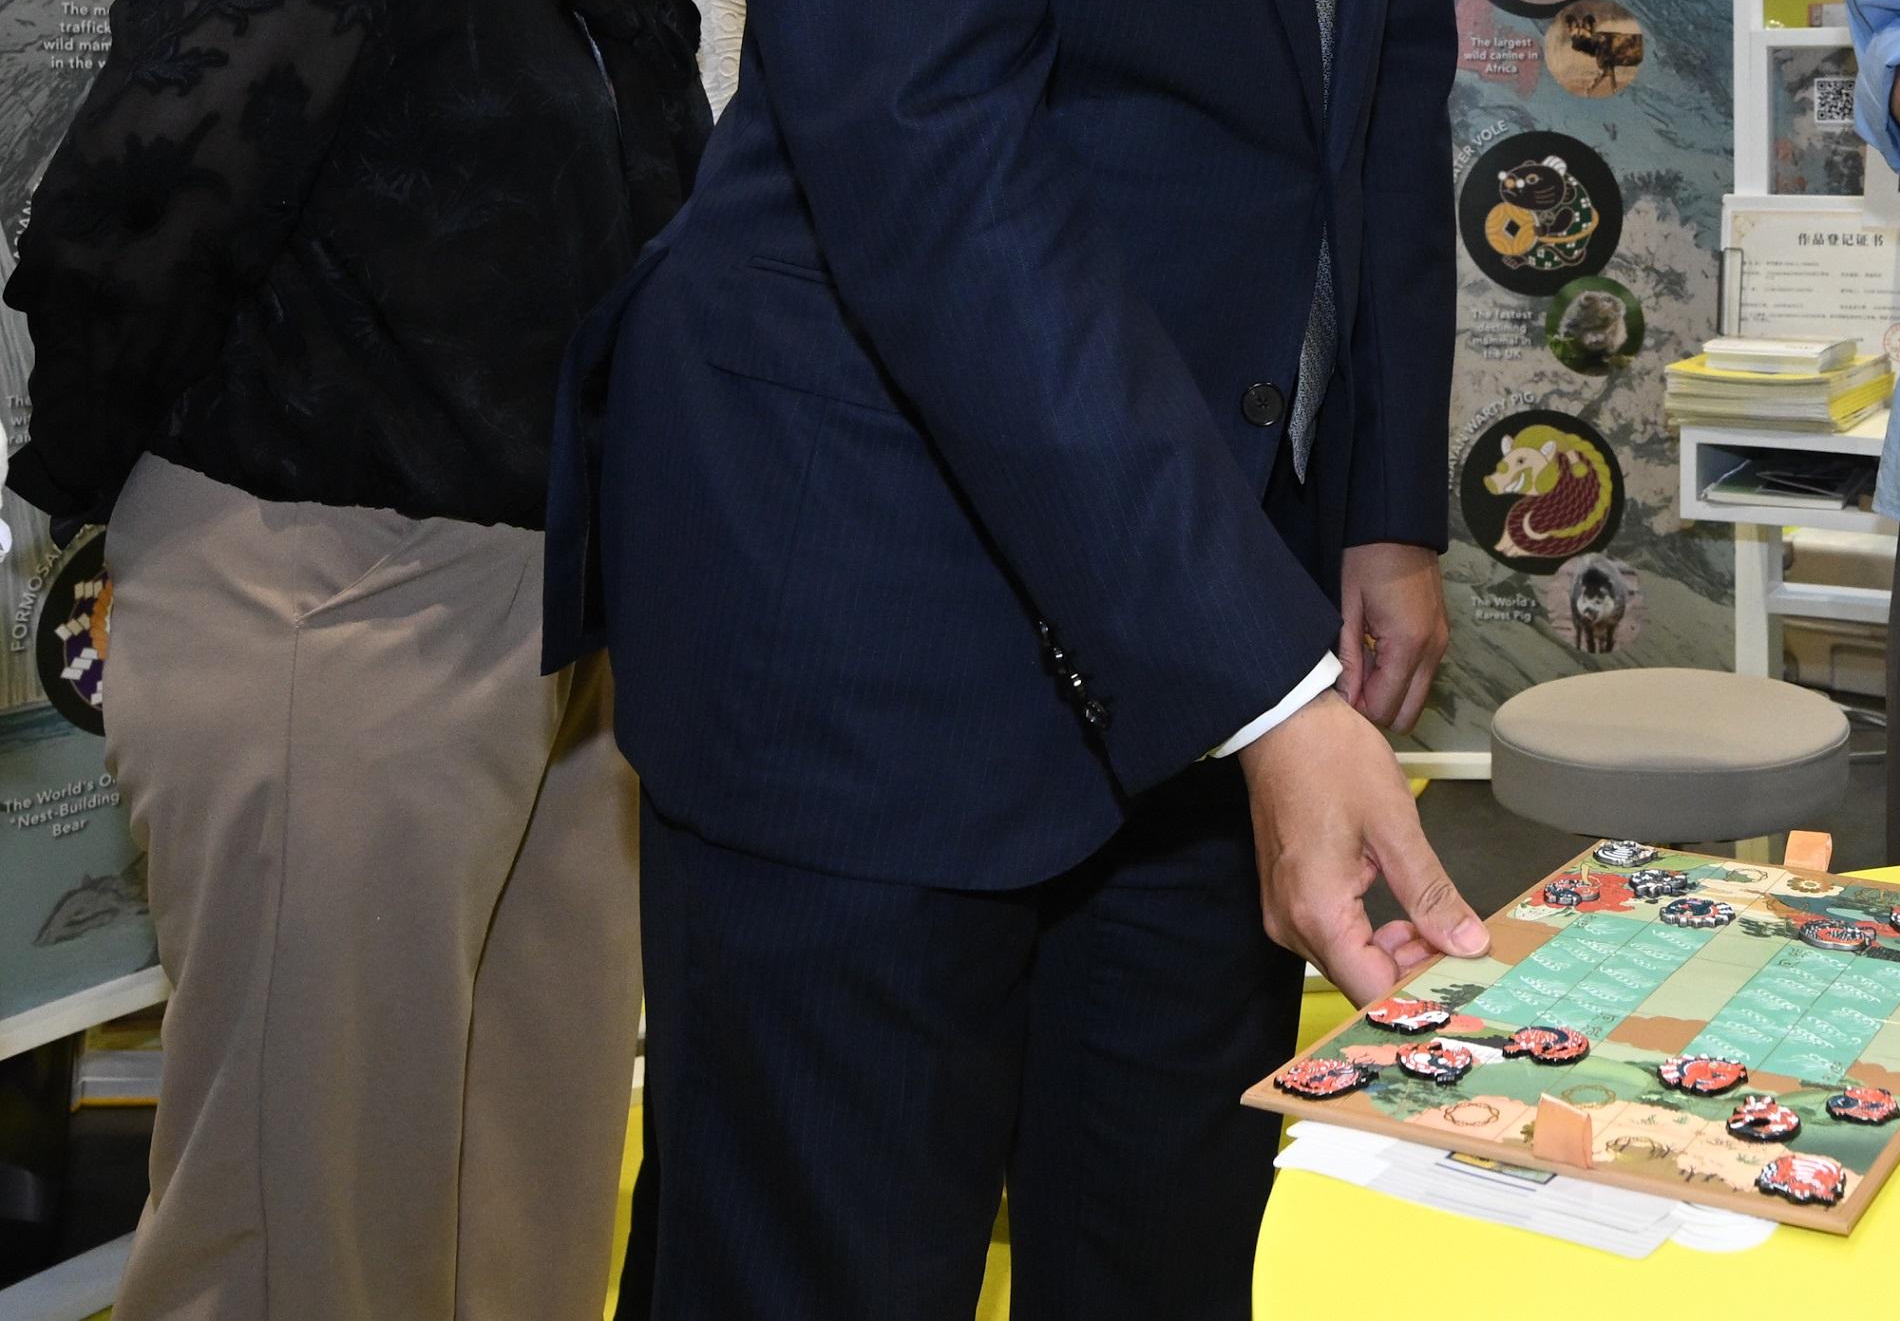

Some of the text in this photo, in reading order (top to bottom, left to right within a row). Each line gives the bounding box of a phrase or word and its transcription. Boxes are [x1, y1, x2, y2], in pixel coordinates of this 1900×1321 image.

[61, 1, 88, 15] The
[43, 38, 74, 53] wild
[1470, 36, 1533, 50] The largest
[51, 55, 63, 69] in
[69, 55, 93, 69] the
[1463, 50, 1488, 61] wild
[1489, 51, 1526, 61] canine
[1484, 63, 1518, 74] Africa
[1453, 119, 1508, 183] ATER VOLE
[1797, 231, 1885, 248] 作品登记证书
[1466, 397, 1507, 436] WARTY
[1510, 390, 1535, 407] PIG
[4, 798, 32, 814] The
[36, 780, 95, 805] World's
[52, 818, 87, 837] Bear
